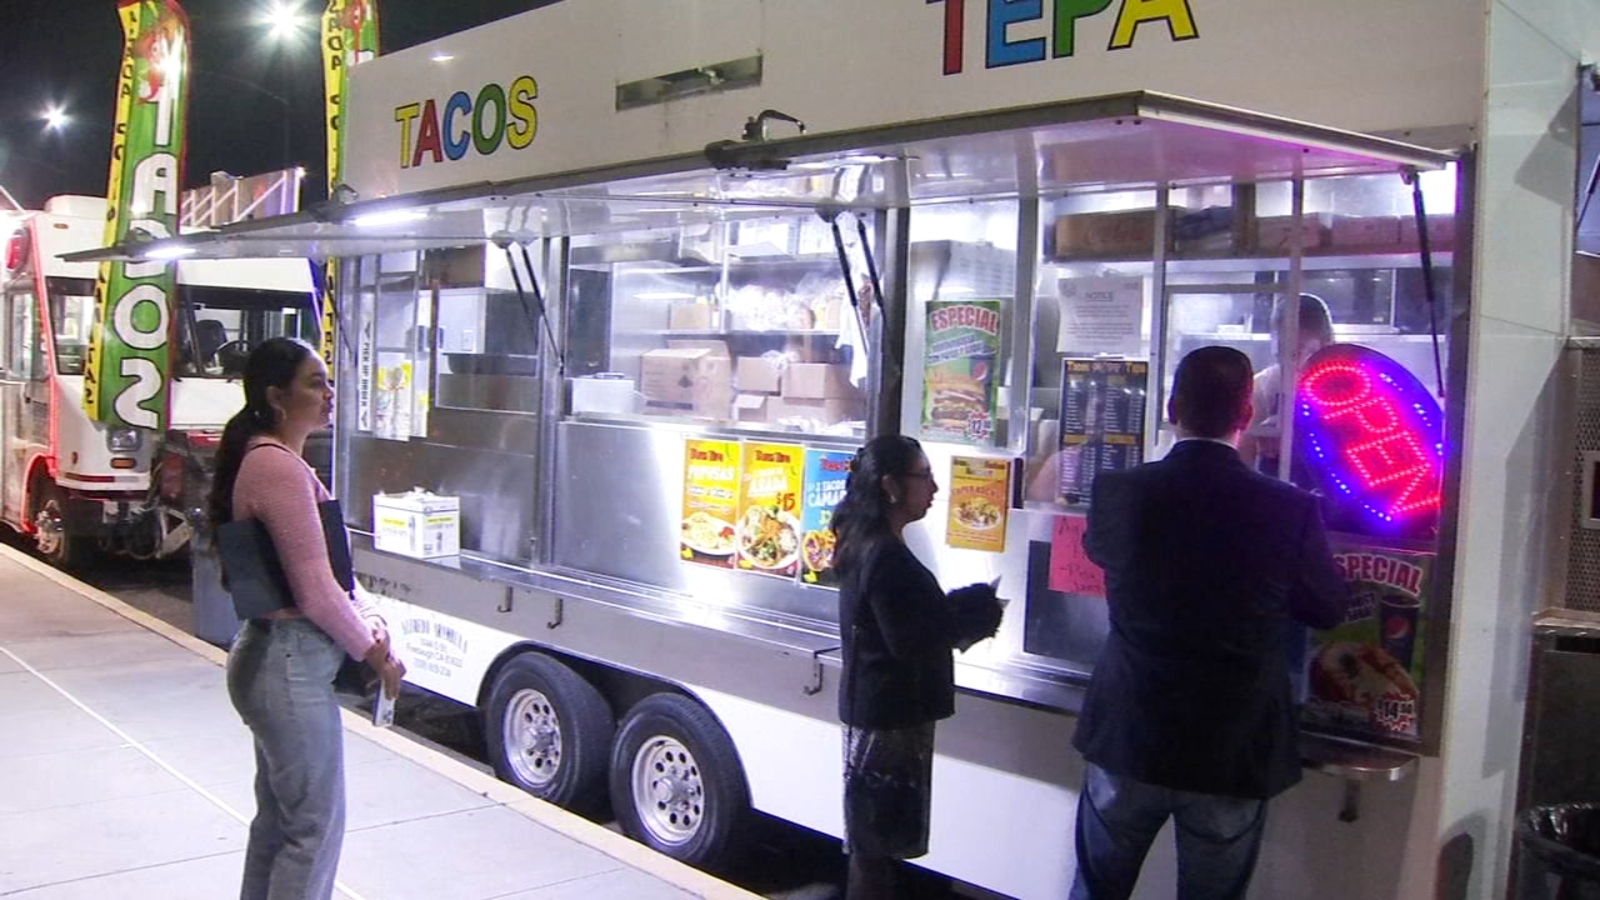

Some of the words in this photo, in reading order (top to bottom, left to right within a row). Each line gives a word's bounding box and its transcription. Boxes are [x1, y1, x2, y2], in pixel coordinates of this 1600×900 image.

[926, 0, 1200, 75] TEPA
[395, 75, 538, 169] TACOS
[930, 305, 999, 335] ESPECIAL
[1304, 363, 1441, 515] OPEN
[1333, 553, 1424, 597] SPECIAL
